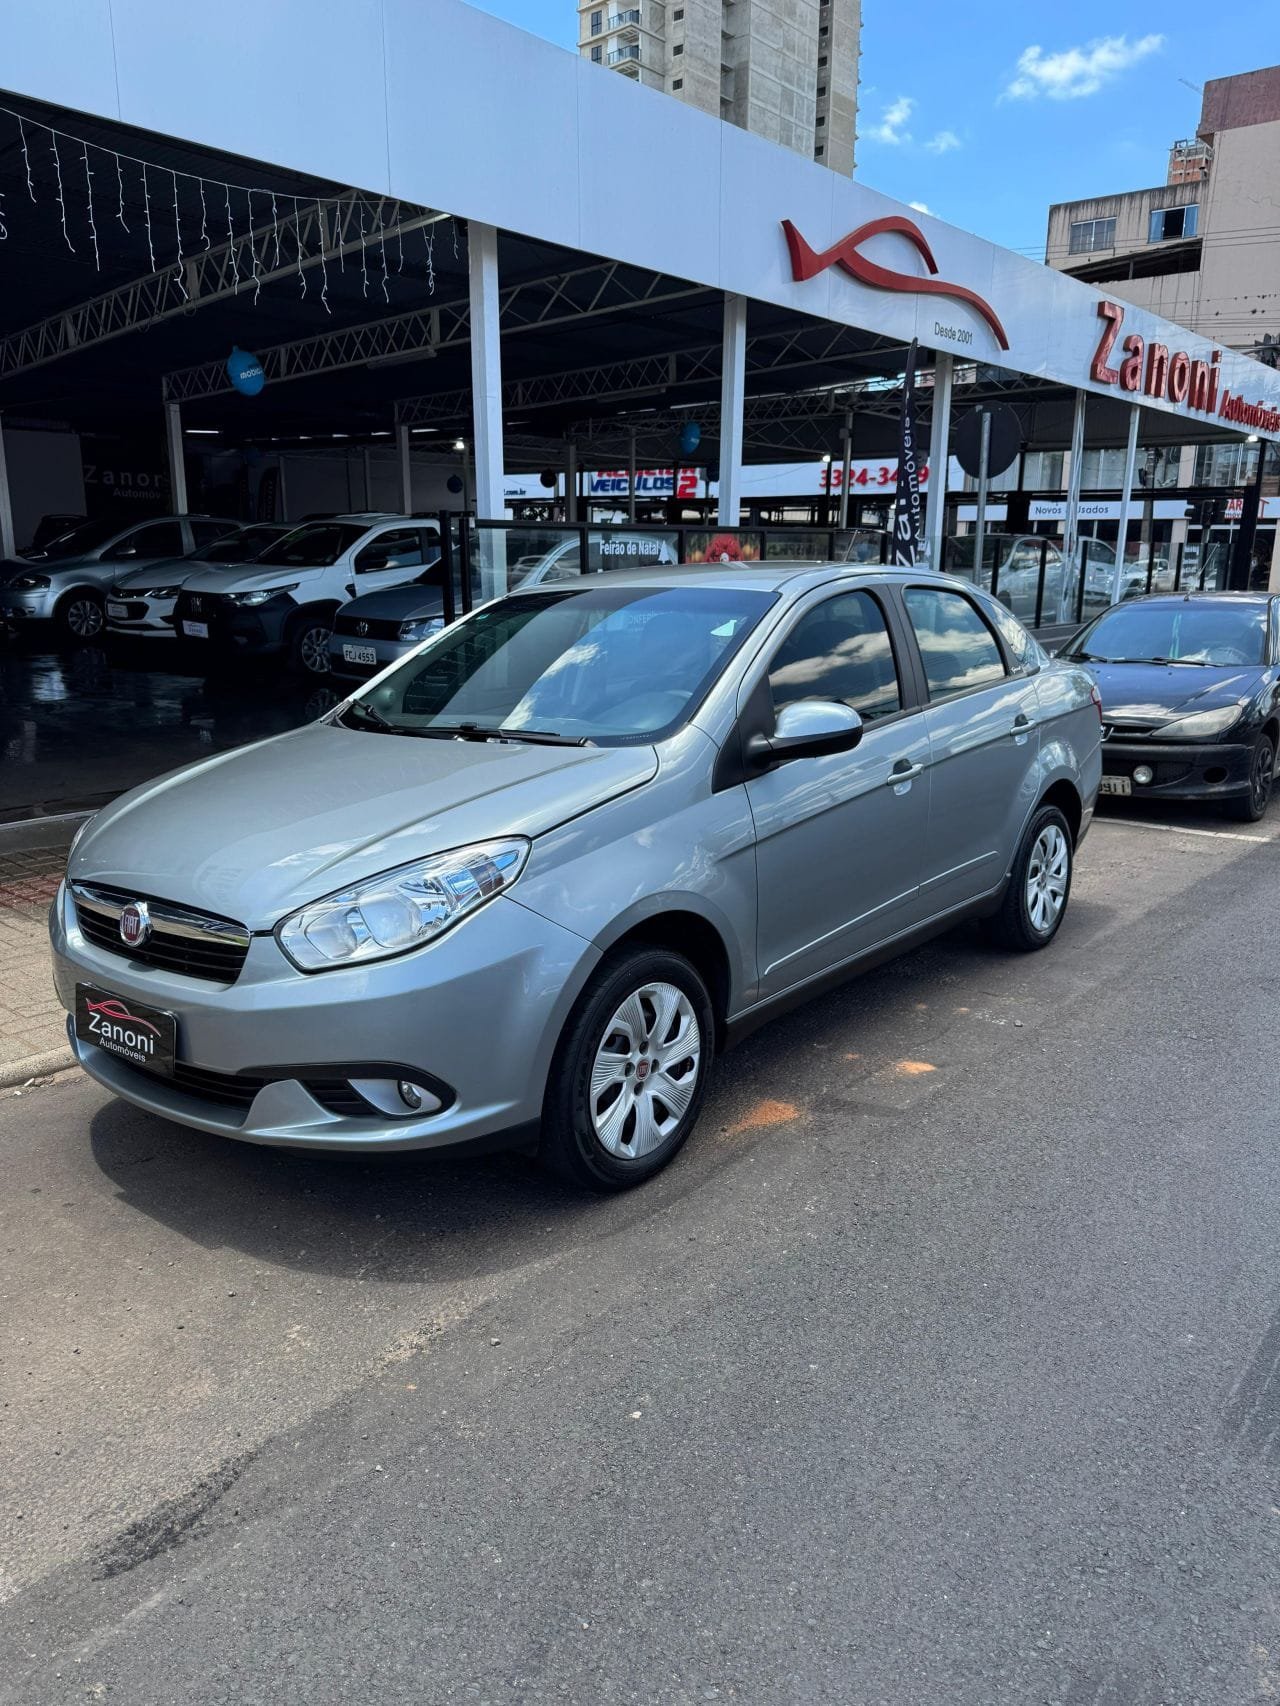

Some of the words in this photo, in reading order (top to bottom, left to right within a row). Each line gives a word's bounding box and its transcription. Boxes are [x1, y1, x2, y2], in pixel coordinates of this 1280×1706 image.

[934, 321, 957, 341] Desde
[957, 328, 974, 345] 2001
[1090, 300, 1222, 414] Zanoni
[677, 475, 698, 498] 2
[1035, 505, 1062, 515] Novos
[599, 540, 625, 555] Feirão
[627, 540, 637, 555] de
[638, 540, 659, 555] Natal
[123, 914, 140, 935] FIAT
[88, 1011, 154, 1055] Zanoni
[99, 1036, 146, 1063] Automóveis
